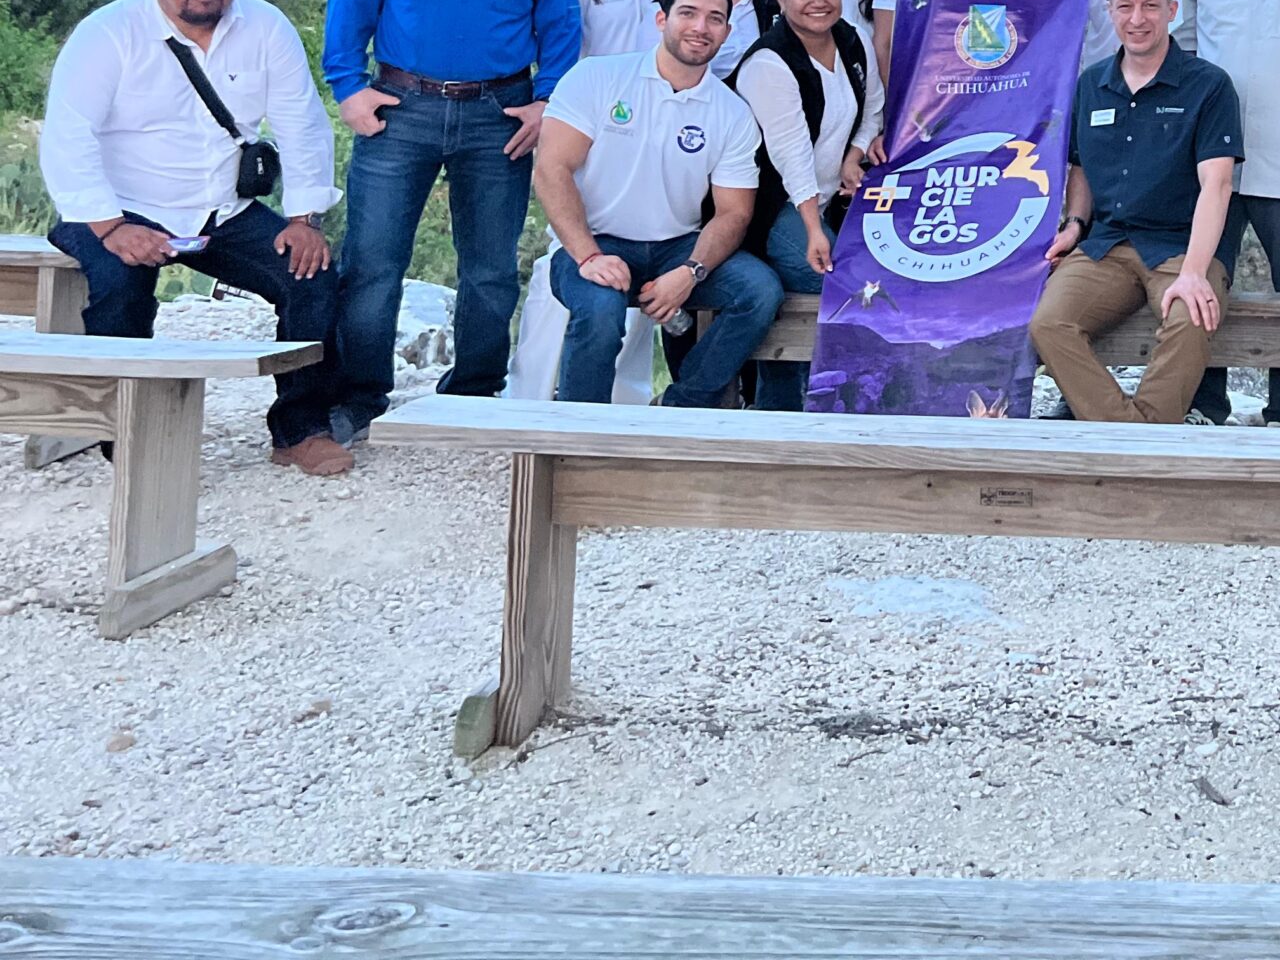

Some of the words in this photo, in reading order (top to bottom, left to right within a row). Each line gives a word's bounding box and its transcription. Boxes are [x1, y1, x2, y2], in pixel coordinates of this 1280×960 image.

[936, 78, 1028, 94] CHIHUAHUA
[925, 166, 1000, 188] MUR
[920, 187, 976, 207] CIE
[914, 206, 957, 225] LA
[872, 230, 890, 252] DE
[898, 214, 1034, 271] CHIHUAHUA
[909, 223, 979, 245] GOS
